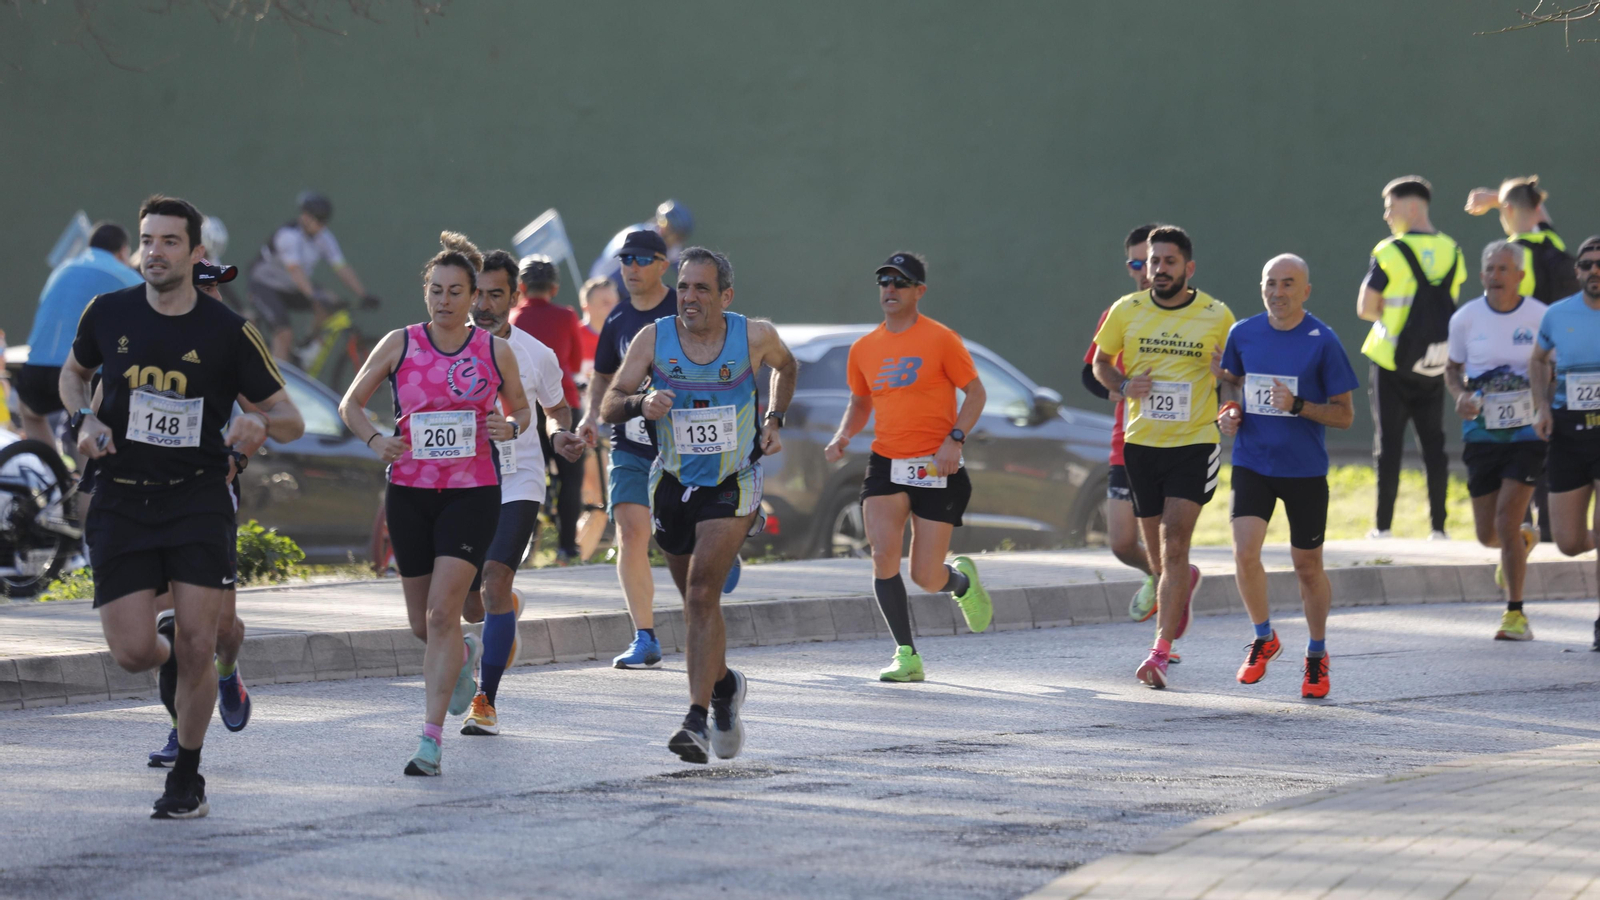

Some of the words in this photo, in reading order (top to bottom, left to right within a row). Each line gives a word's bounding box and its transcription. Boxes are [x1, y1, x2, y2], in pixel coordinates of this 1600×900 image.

[1138, 338, 1204, 349] TESORILLO
[1138, 346, 1203, 358] SECADERO
[123, 365, 187, 396] 100
[1148, 395, 1174, 411] 129
[1255, 389, 1273, 405] 12
[1498, 405, 1515, 420] 20
[145, 413, 180, 436] 148
[639, 420, 647, 434] 9
[146, 436, 181, 446] EVOS
[424, 428, 456, 448] 260
[686, 424, 718, 443] 133
